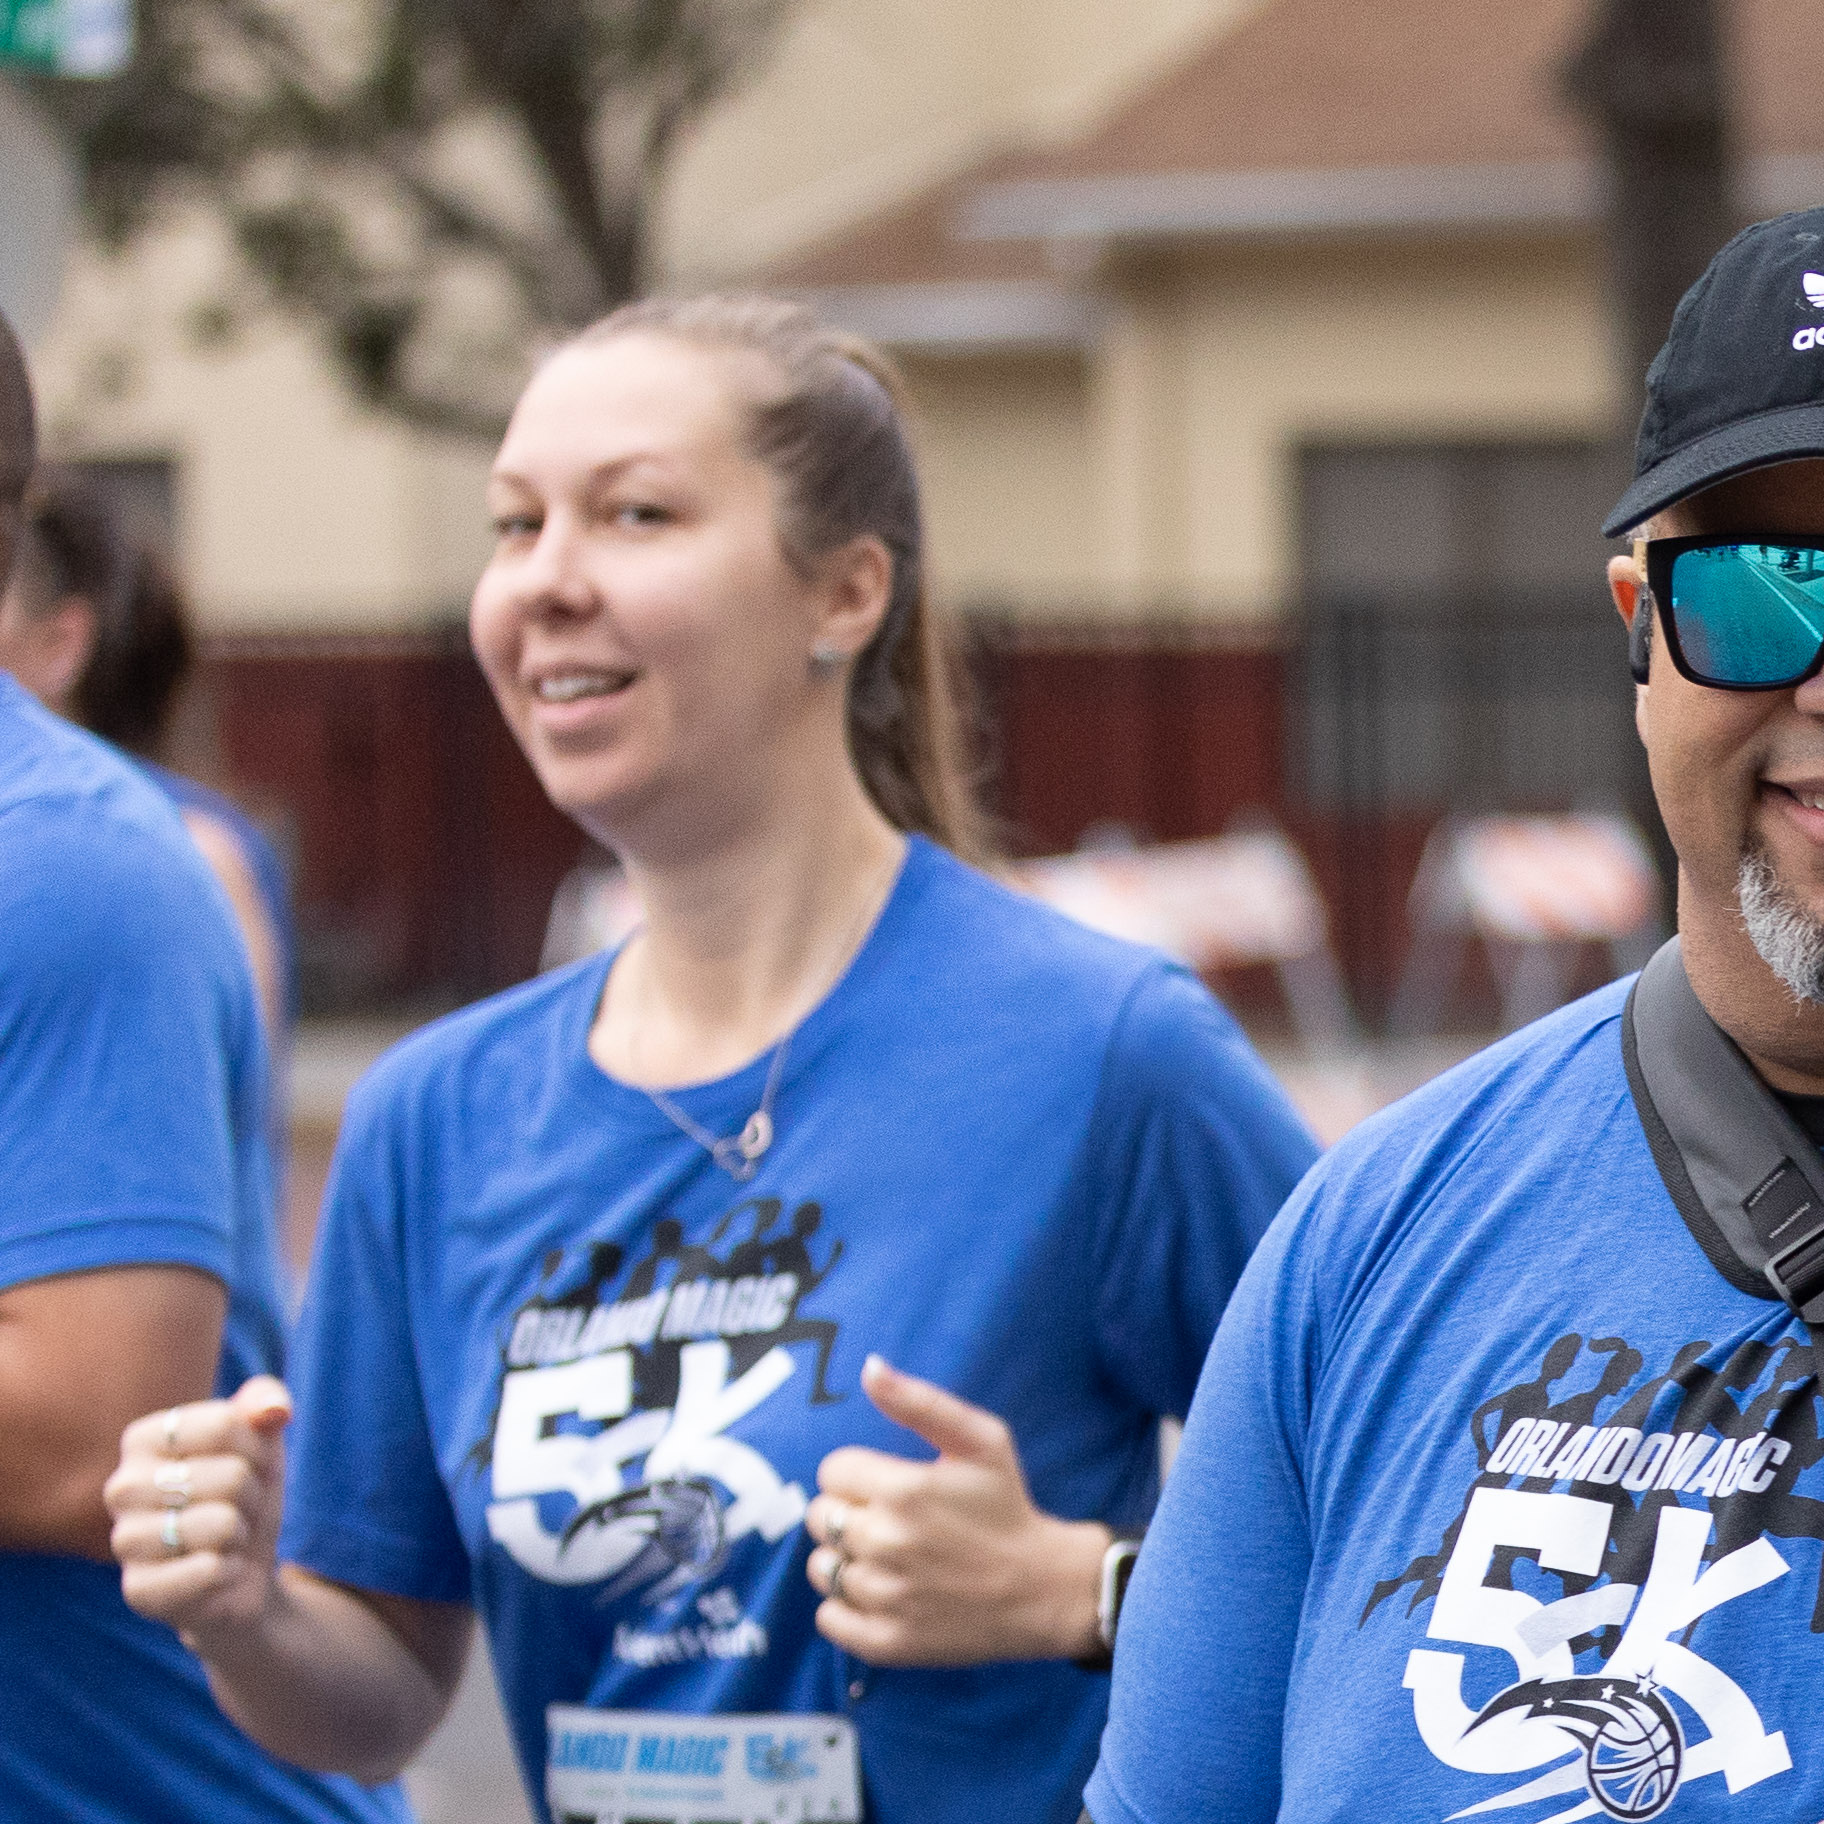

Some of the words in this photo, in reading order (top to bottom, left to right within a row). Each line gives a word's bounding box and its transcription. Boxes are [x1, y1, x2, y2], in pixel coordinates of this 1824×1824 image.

[486, 1339, 809, 1584] 5K
[1485, 1417, 1675, 1493] ORLANDO
[1401, 1486, 1793, 1795] 5K
